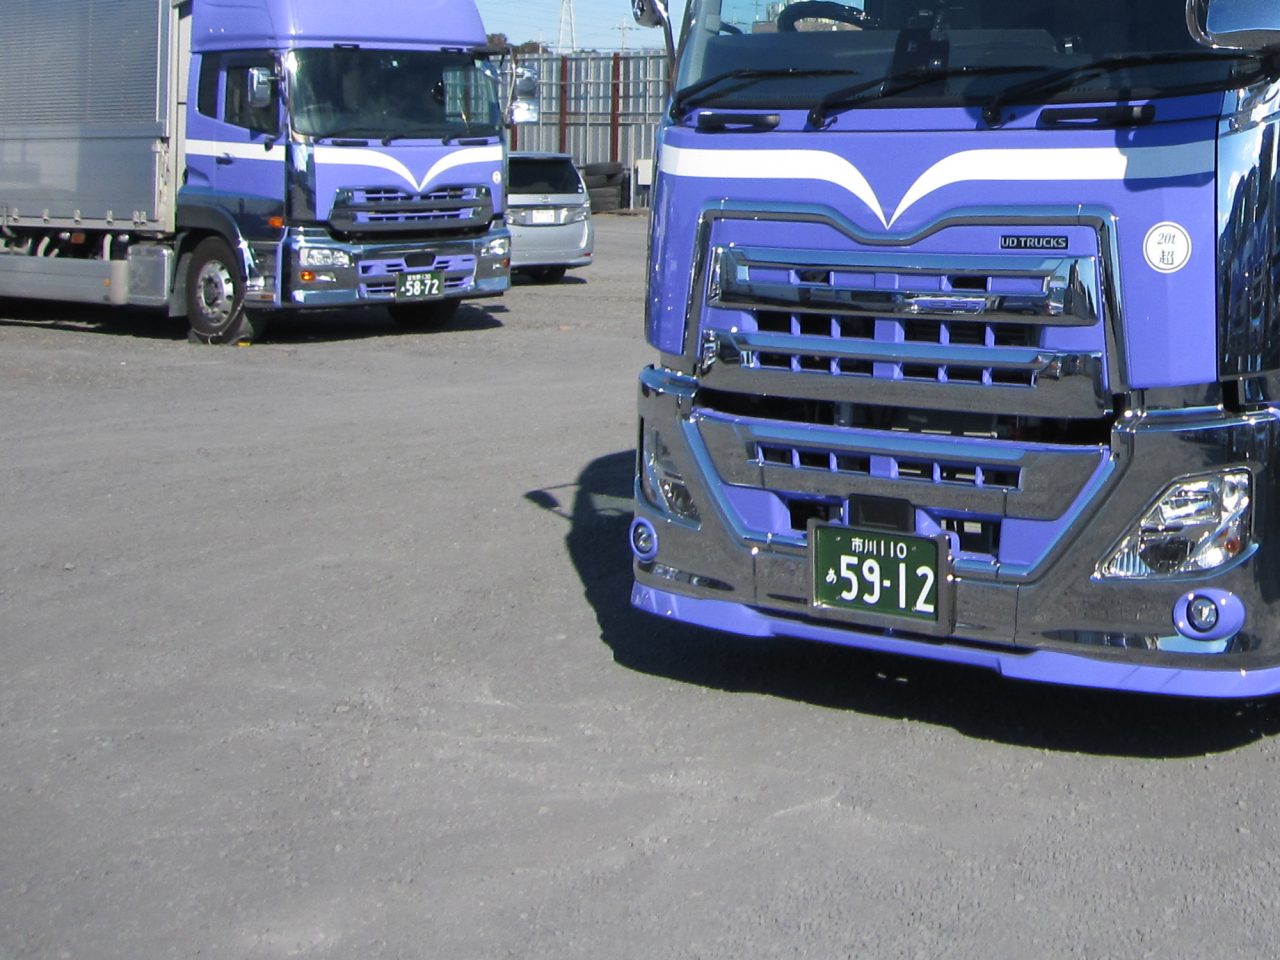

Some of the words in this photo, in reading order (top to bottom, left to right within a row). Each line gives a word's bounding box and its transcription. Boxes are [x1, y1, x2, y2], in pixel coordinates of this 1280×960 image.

[1001, 237, 1017, 248] UD
[1019, 237, 1067, 248] TRUCKS
[405, 279, 439, 296] 58-72
[826, 568, 837, 584] あ
[840, 555, 934, 613] 59-12
